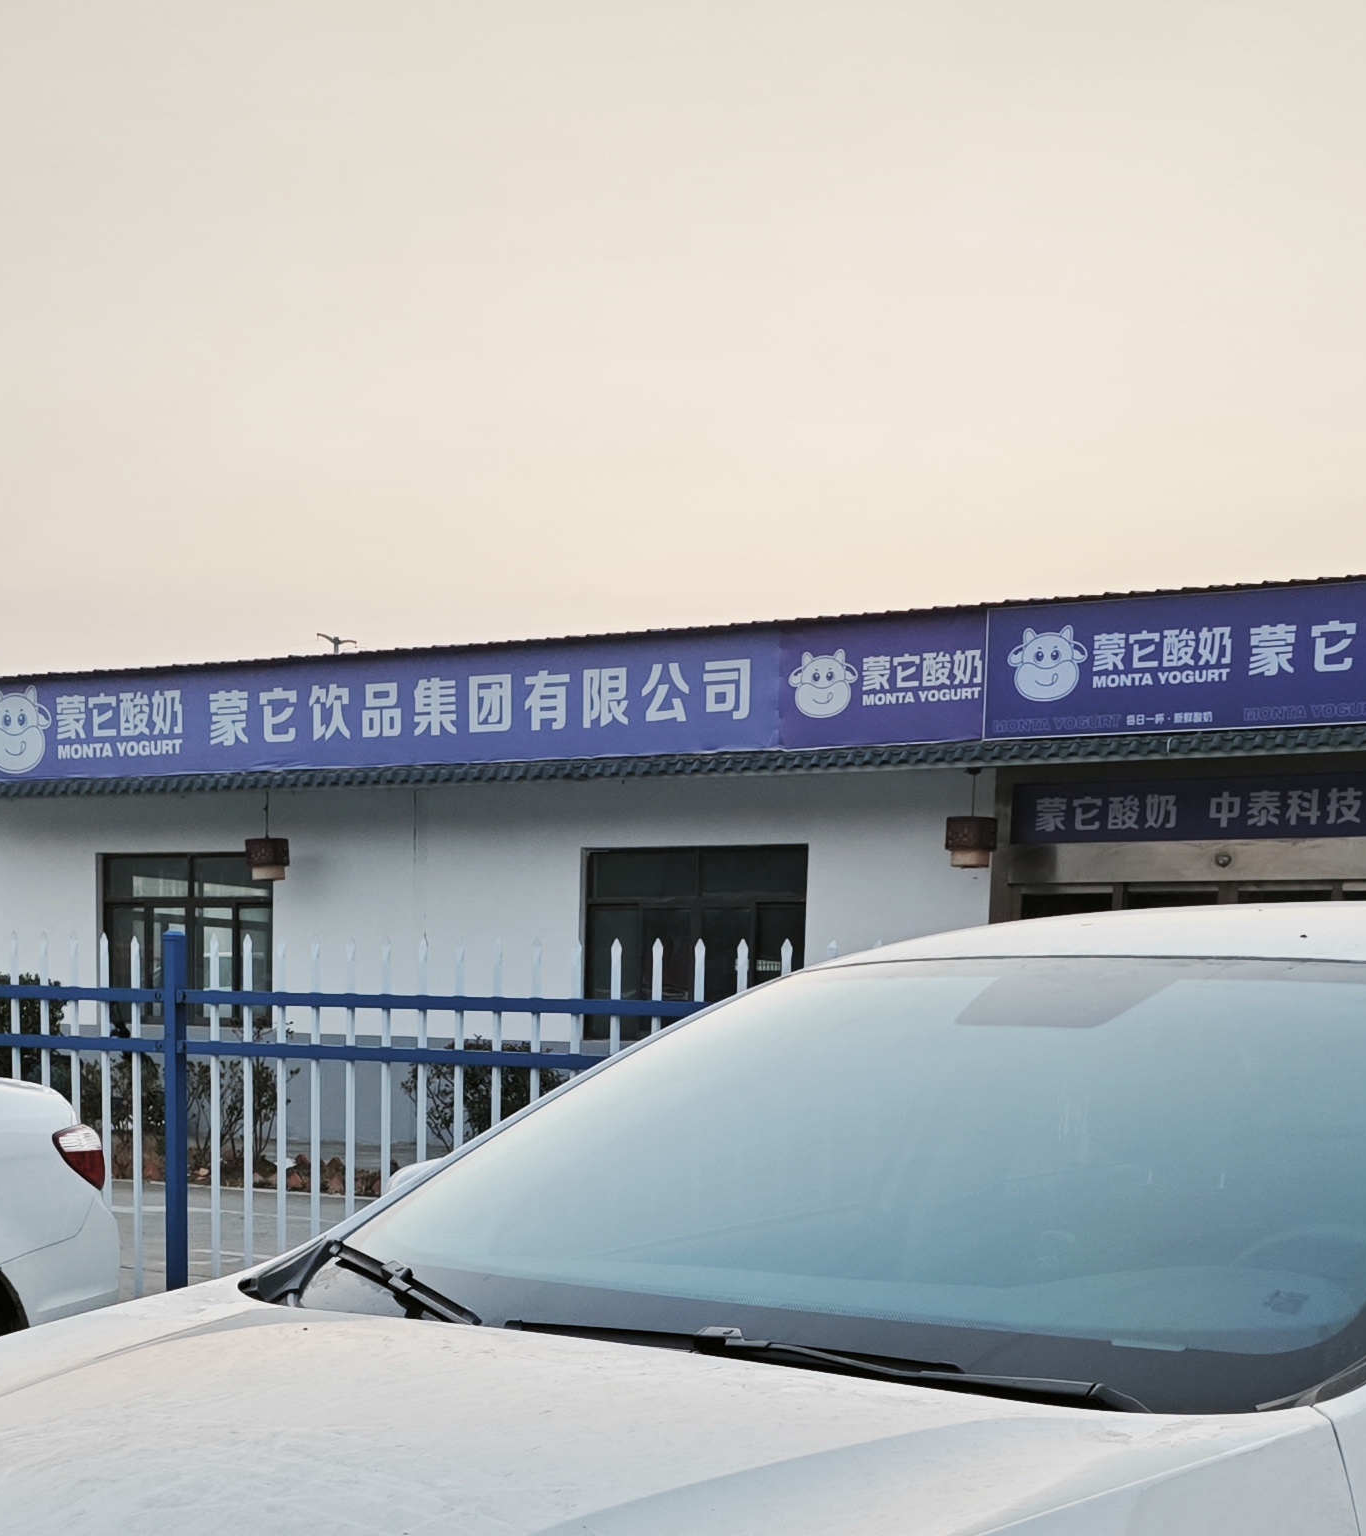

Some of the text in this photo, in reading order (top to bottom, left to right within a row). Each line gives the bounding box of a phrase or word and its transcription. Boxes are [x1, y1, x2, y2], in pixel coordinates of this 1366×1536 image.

[1092, 626, 1232, 672] 蒙它酸奶
[861, 649, 983, 693] 蒙它酸奶
[1092, 668, 1231, 689] MONTA YOGURT
[209, 658, 751, 747] 蒙它饮品集团有限公司
[862, 686, 982, 707] MONTA YOGURT
[56, 690, 183, 740] 蒙它酸奶
[992, 714, 1122, 733] MONTA YOGURT
[1243, 705, 1308, 722] MONTA
[57, 739, 183, 760] MONTA YOGURT
[1035, 793, 1178, 833] 蒙它酸奶
